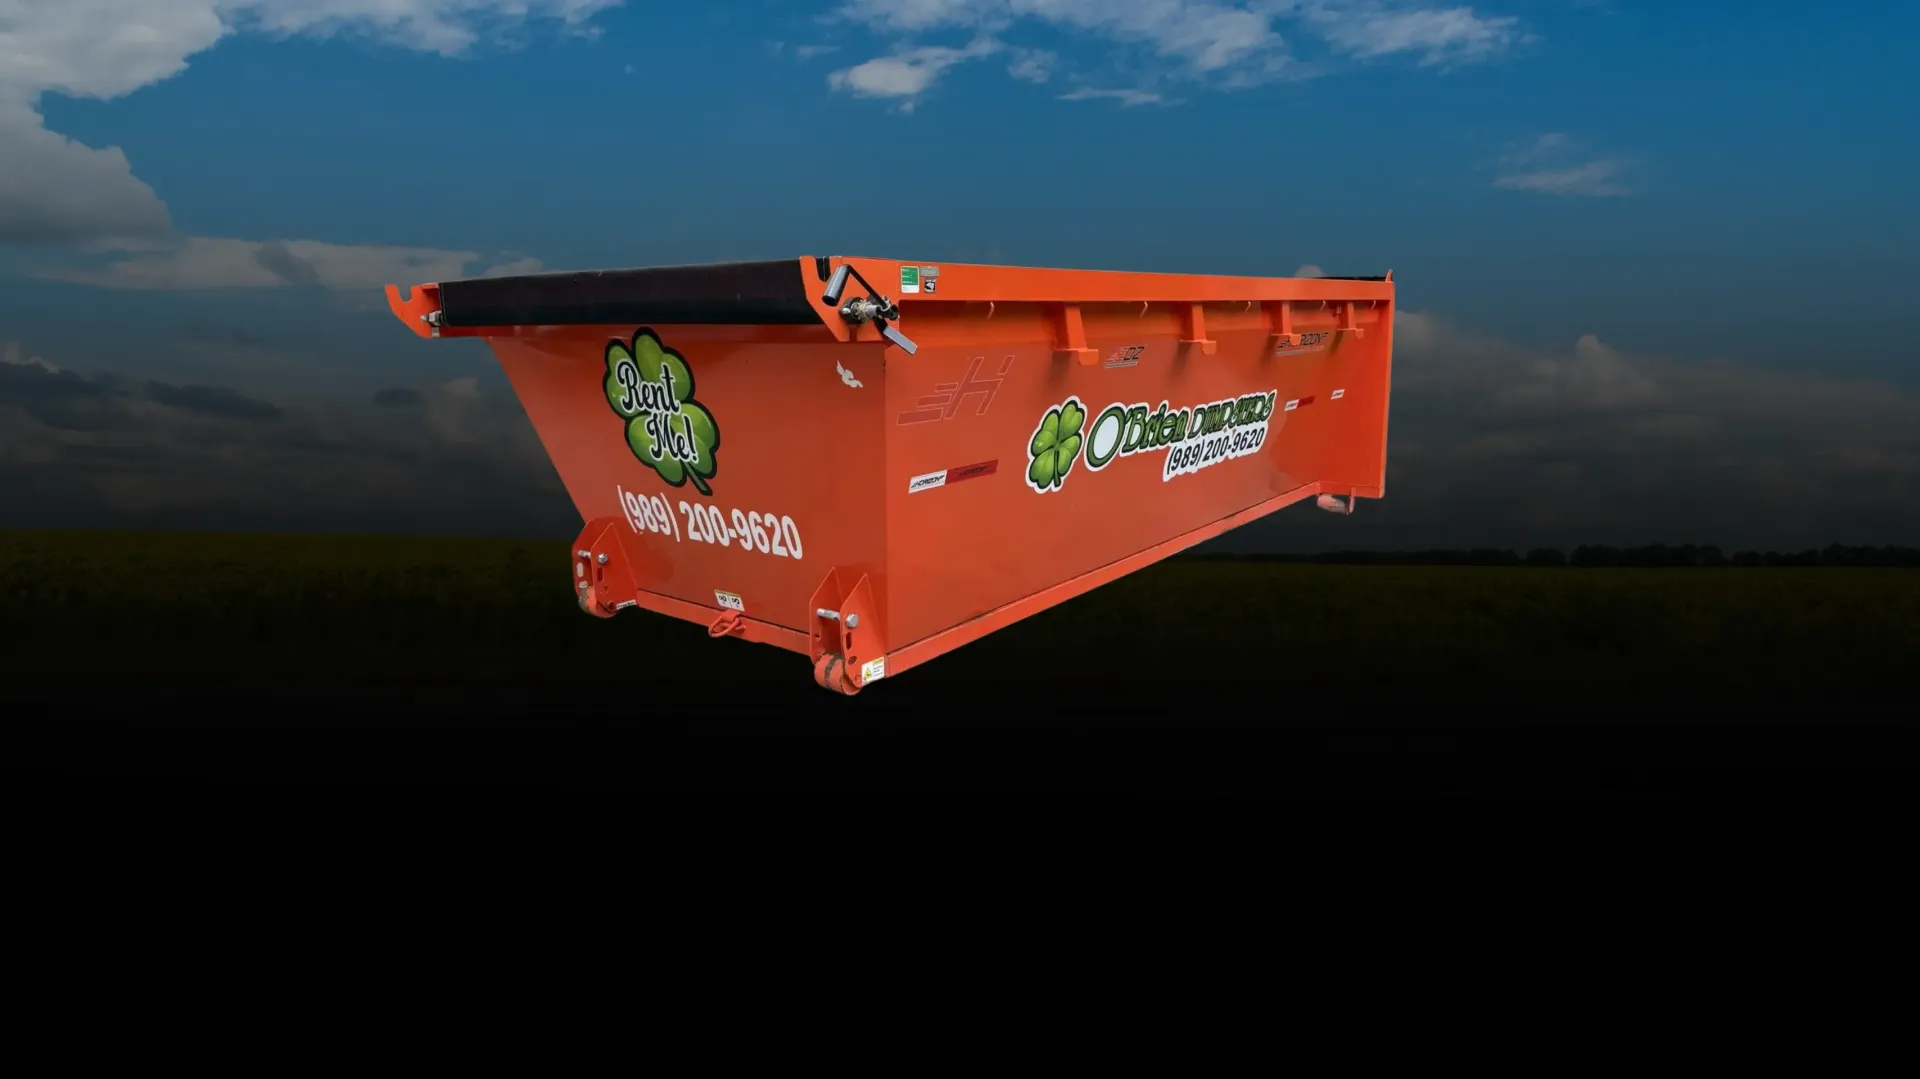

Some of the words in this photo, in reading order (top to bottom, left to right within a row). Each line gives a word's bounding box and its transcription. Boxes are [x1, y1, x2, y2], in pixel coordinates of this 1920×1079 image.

[617, 361, 680, 413] Rent
[646, 413, 699, 462] Me!
[1086, 403, 1189, 468] O'Brien
[1166, 438, 1206, 475] (989)
[1202, 427, 1266, 462] 200-9620
[617, 484, 681, 543] (989)
[679, 500, 803, 560] 200-9620
